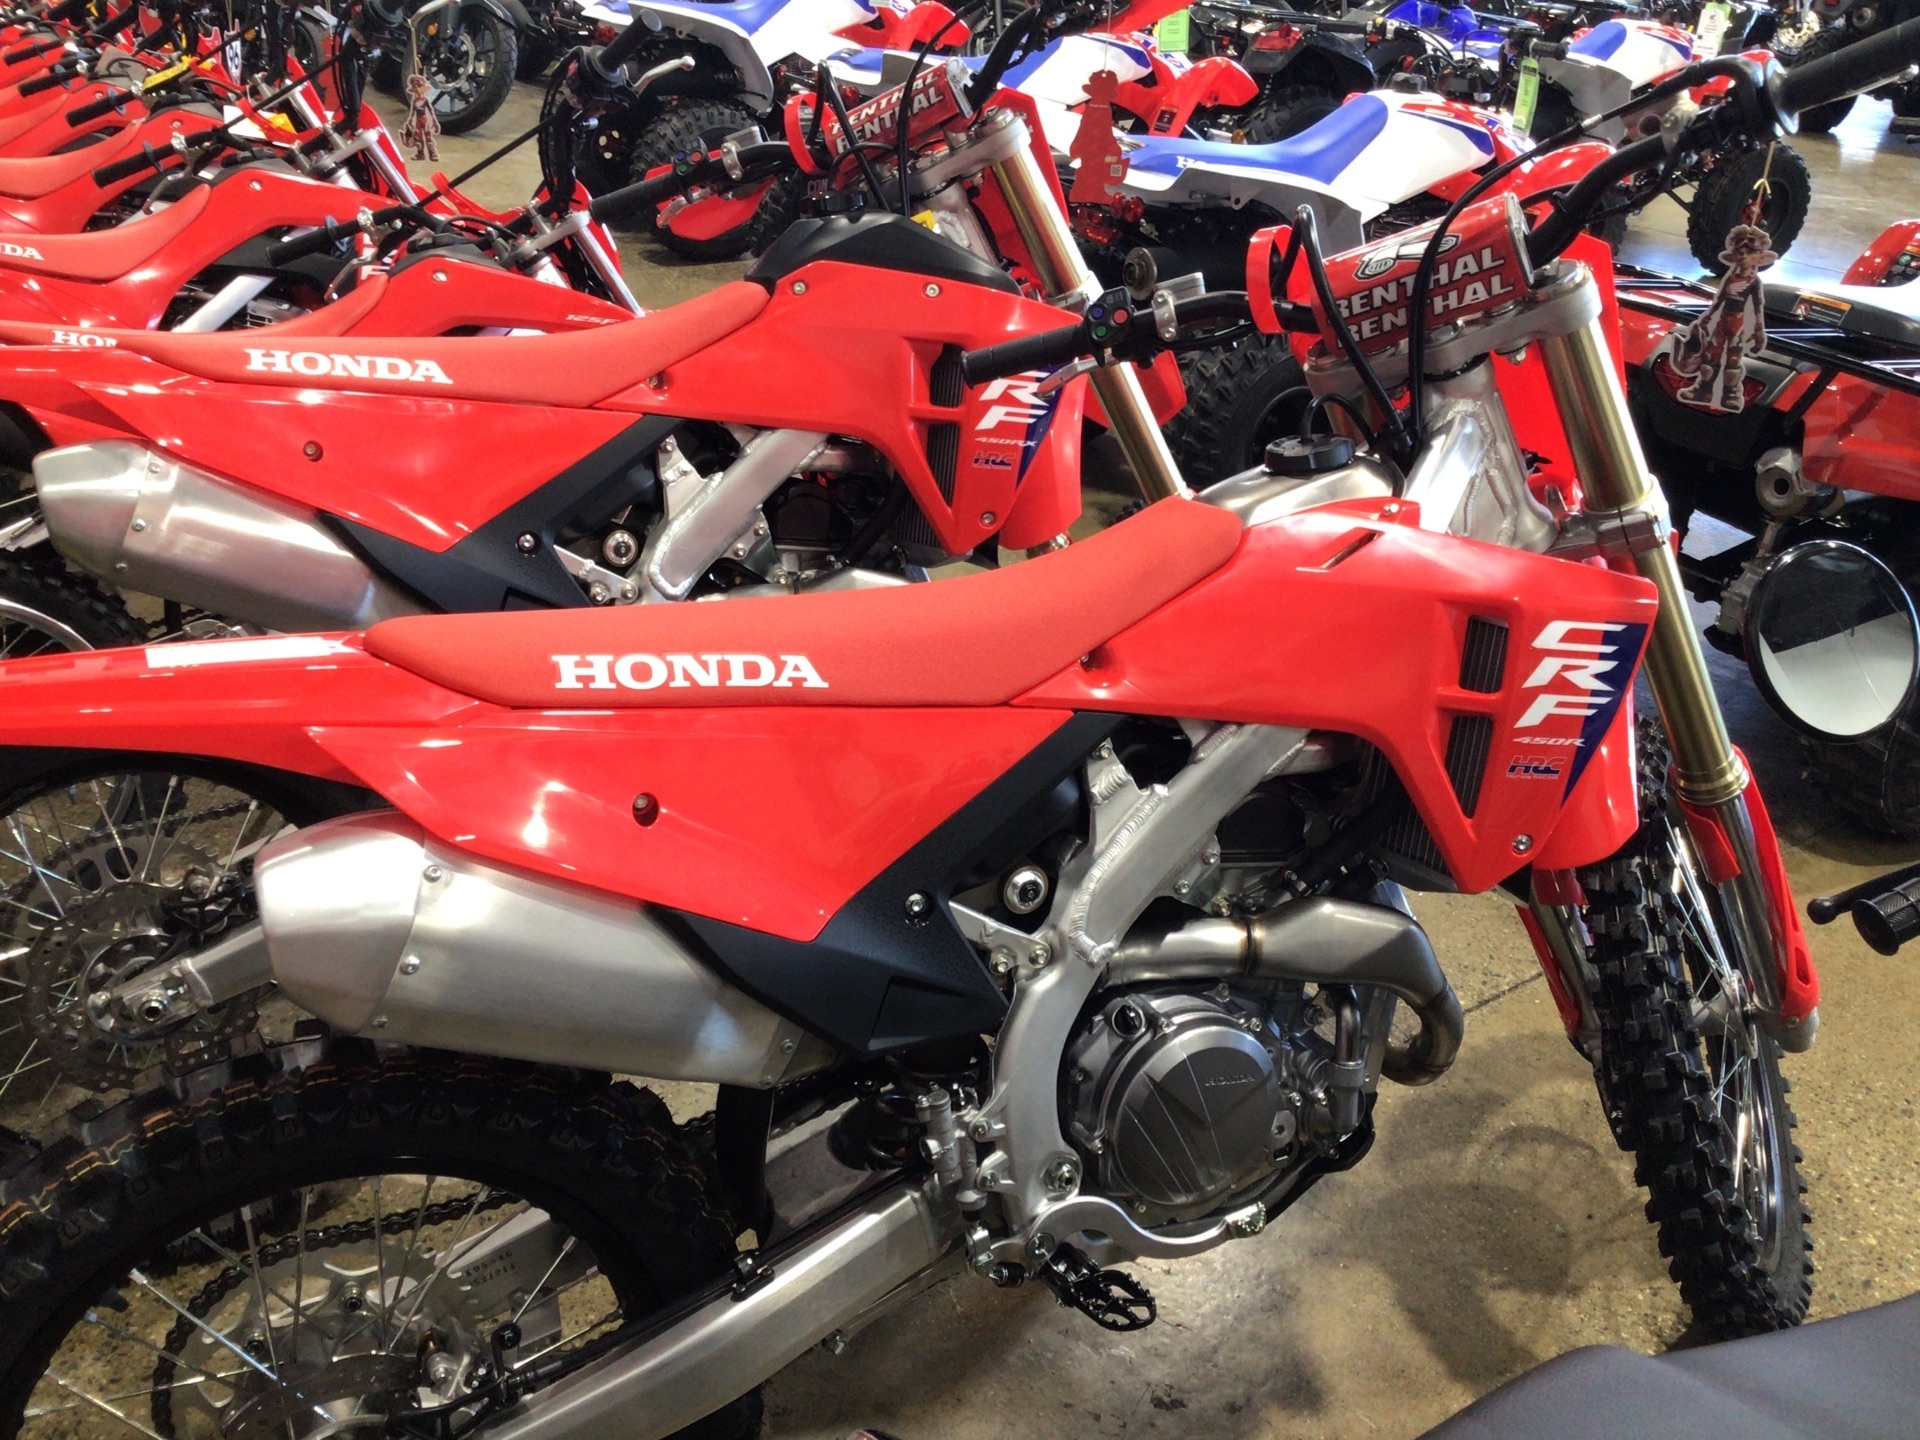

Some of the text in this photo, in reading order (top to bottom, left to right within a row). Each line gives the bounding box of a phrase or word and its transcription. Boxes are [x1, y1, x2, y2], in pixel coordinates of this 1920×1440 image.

[1338, 274, 1514, 348] RENHAL
[244, 348, 454, 385] HONDA
[974, 370, 1051, 430] RF
[972, 450, 1016, 467] HRC
[974, 436, 1038, 447] 450RX
[551, 653, 829, 690] HONDA
[1513, 620, 1628, 729] CRF
[1512, 736, 1587, 747] 450R
[1507, 755, 1567, 776] HRC
